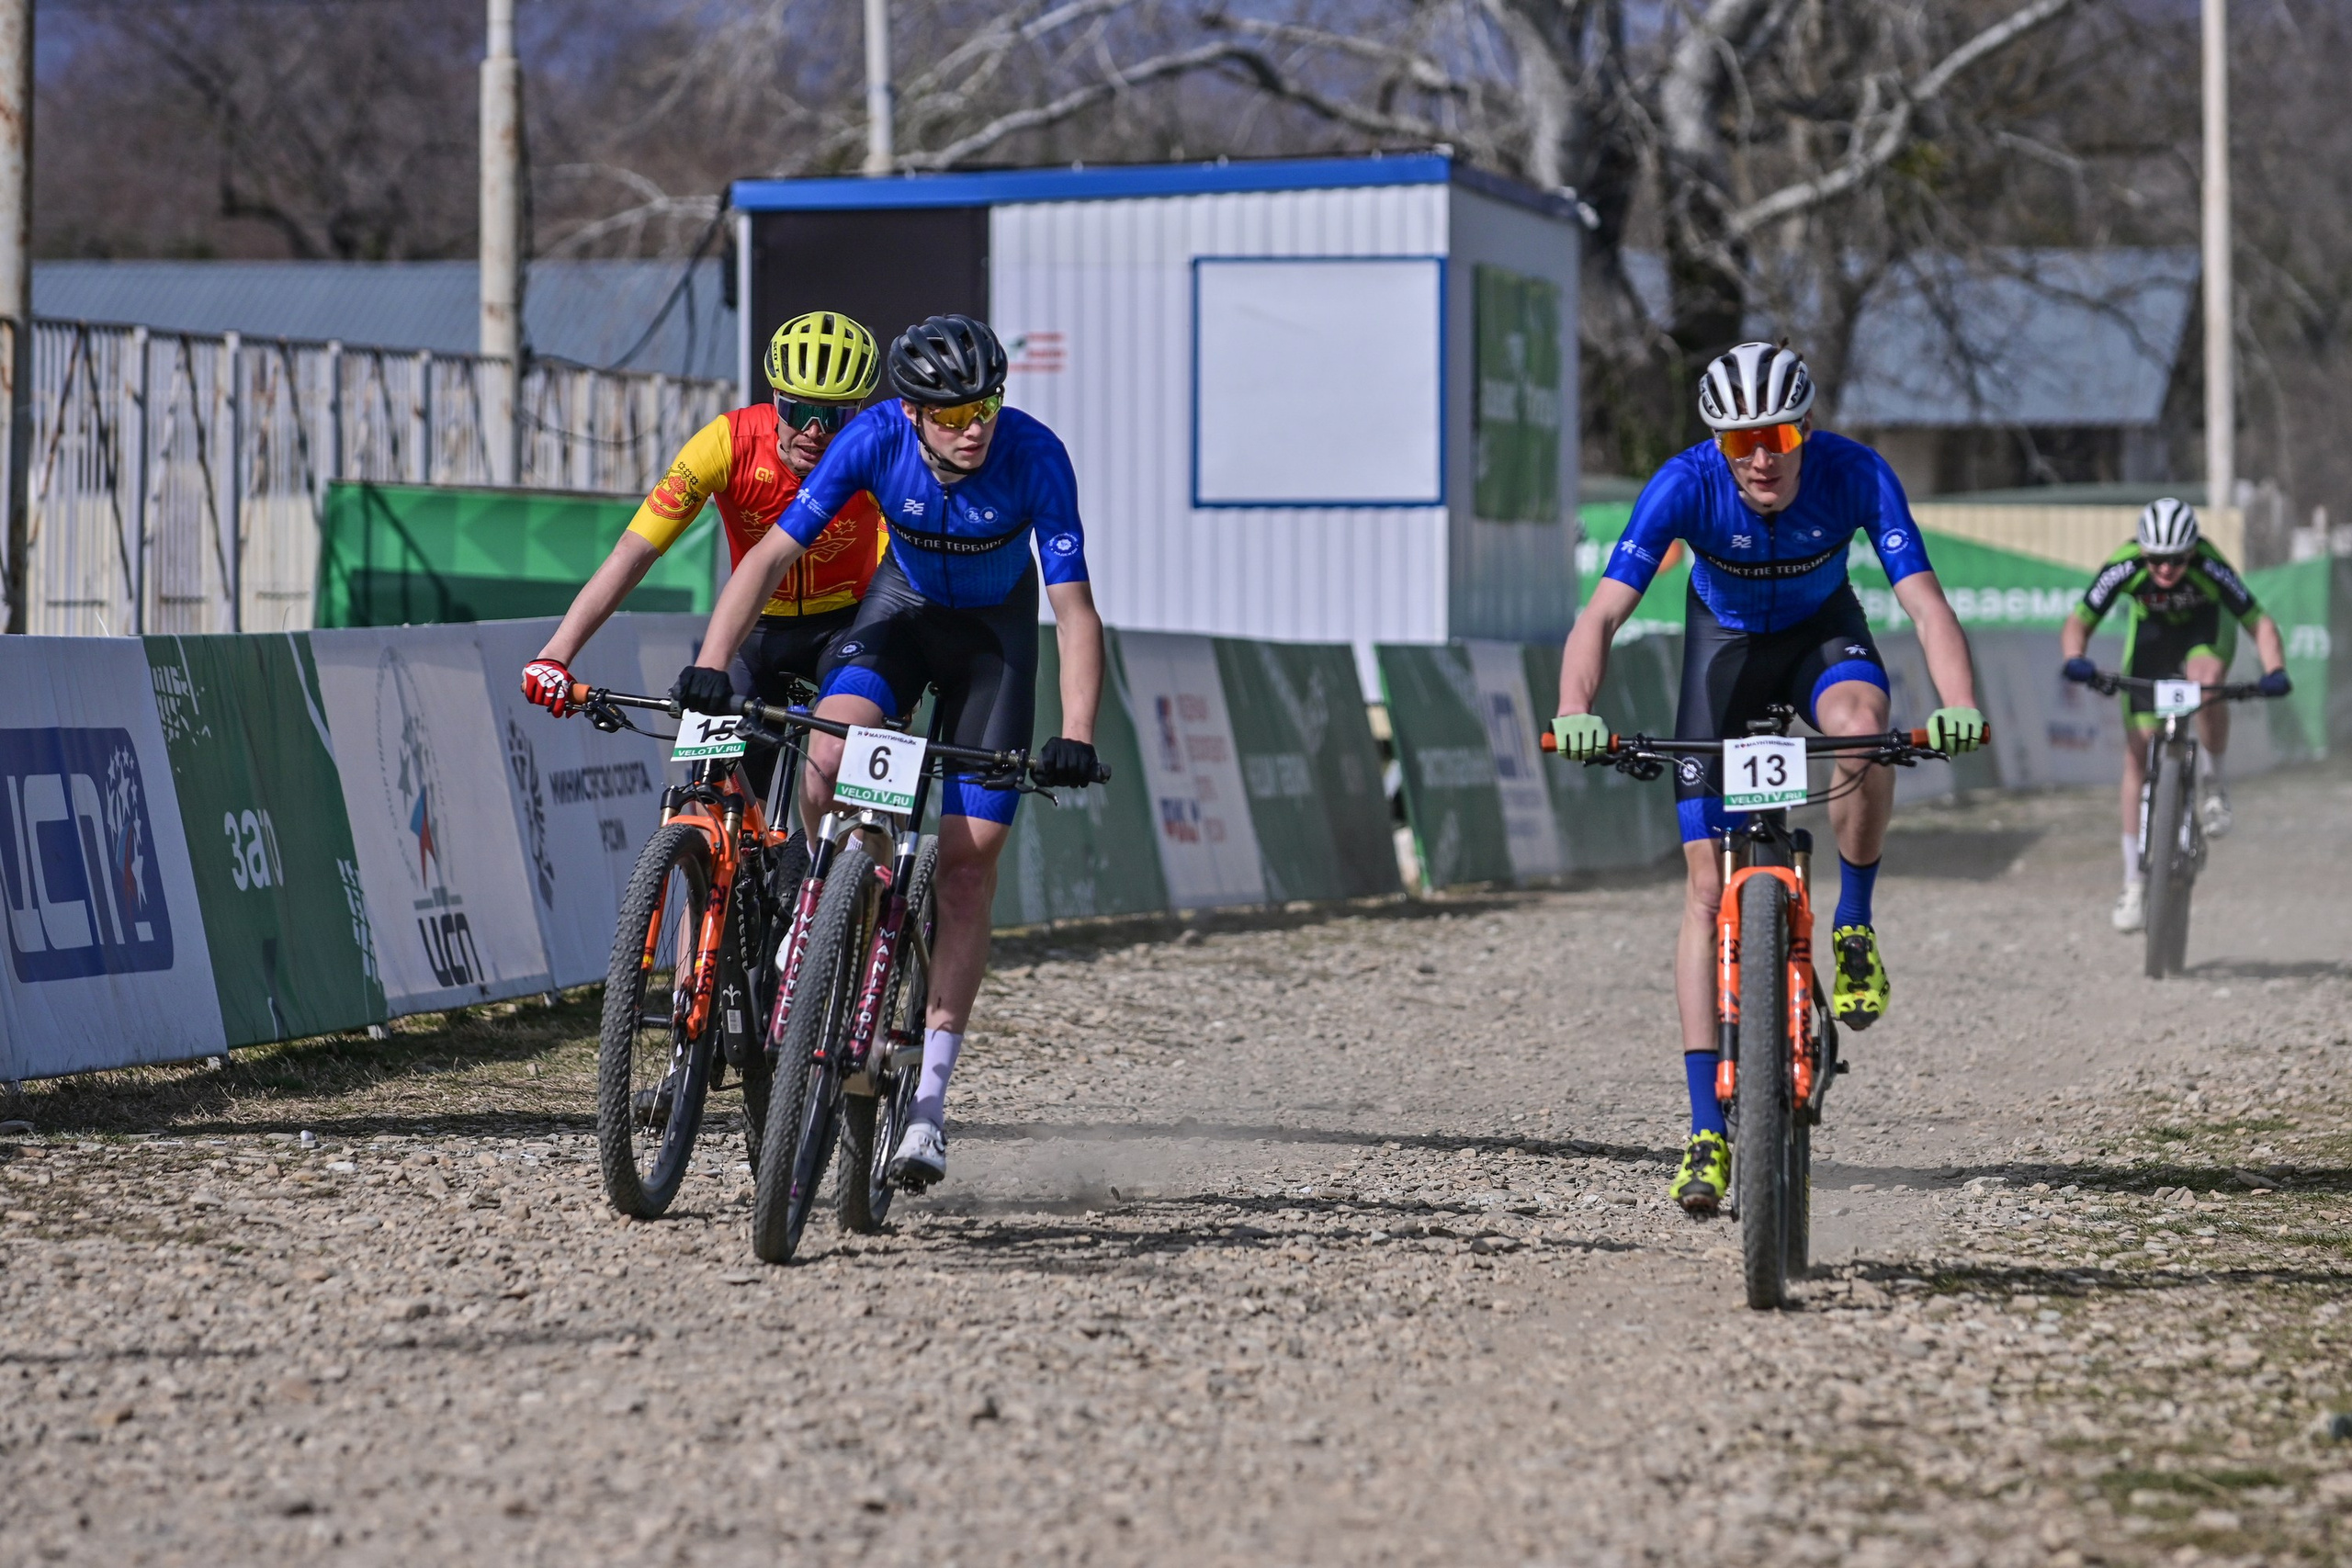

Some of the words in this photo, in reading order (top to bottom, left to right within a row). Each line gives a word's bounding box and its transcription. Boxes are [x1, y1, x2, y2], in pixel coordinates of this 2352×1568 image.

[696, 719, 738, 743] 15
[1743, 753, 1788, 788] 13
[854, 927, 896, 1041] MANITOU
